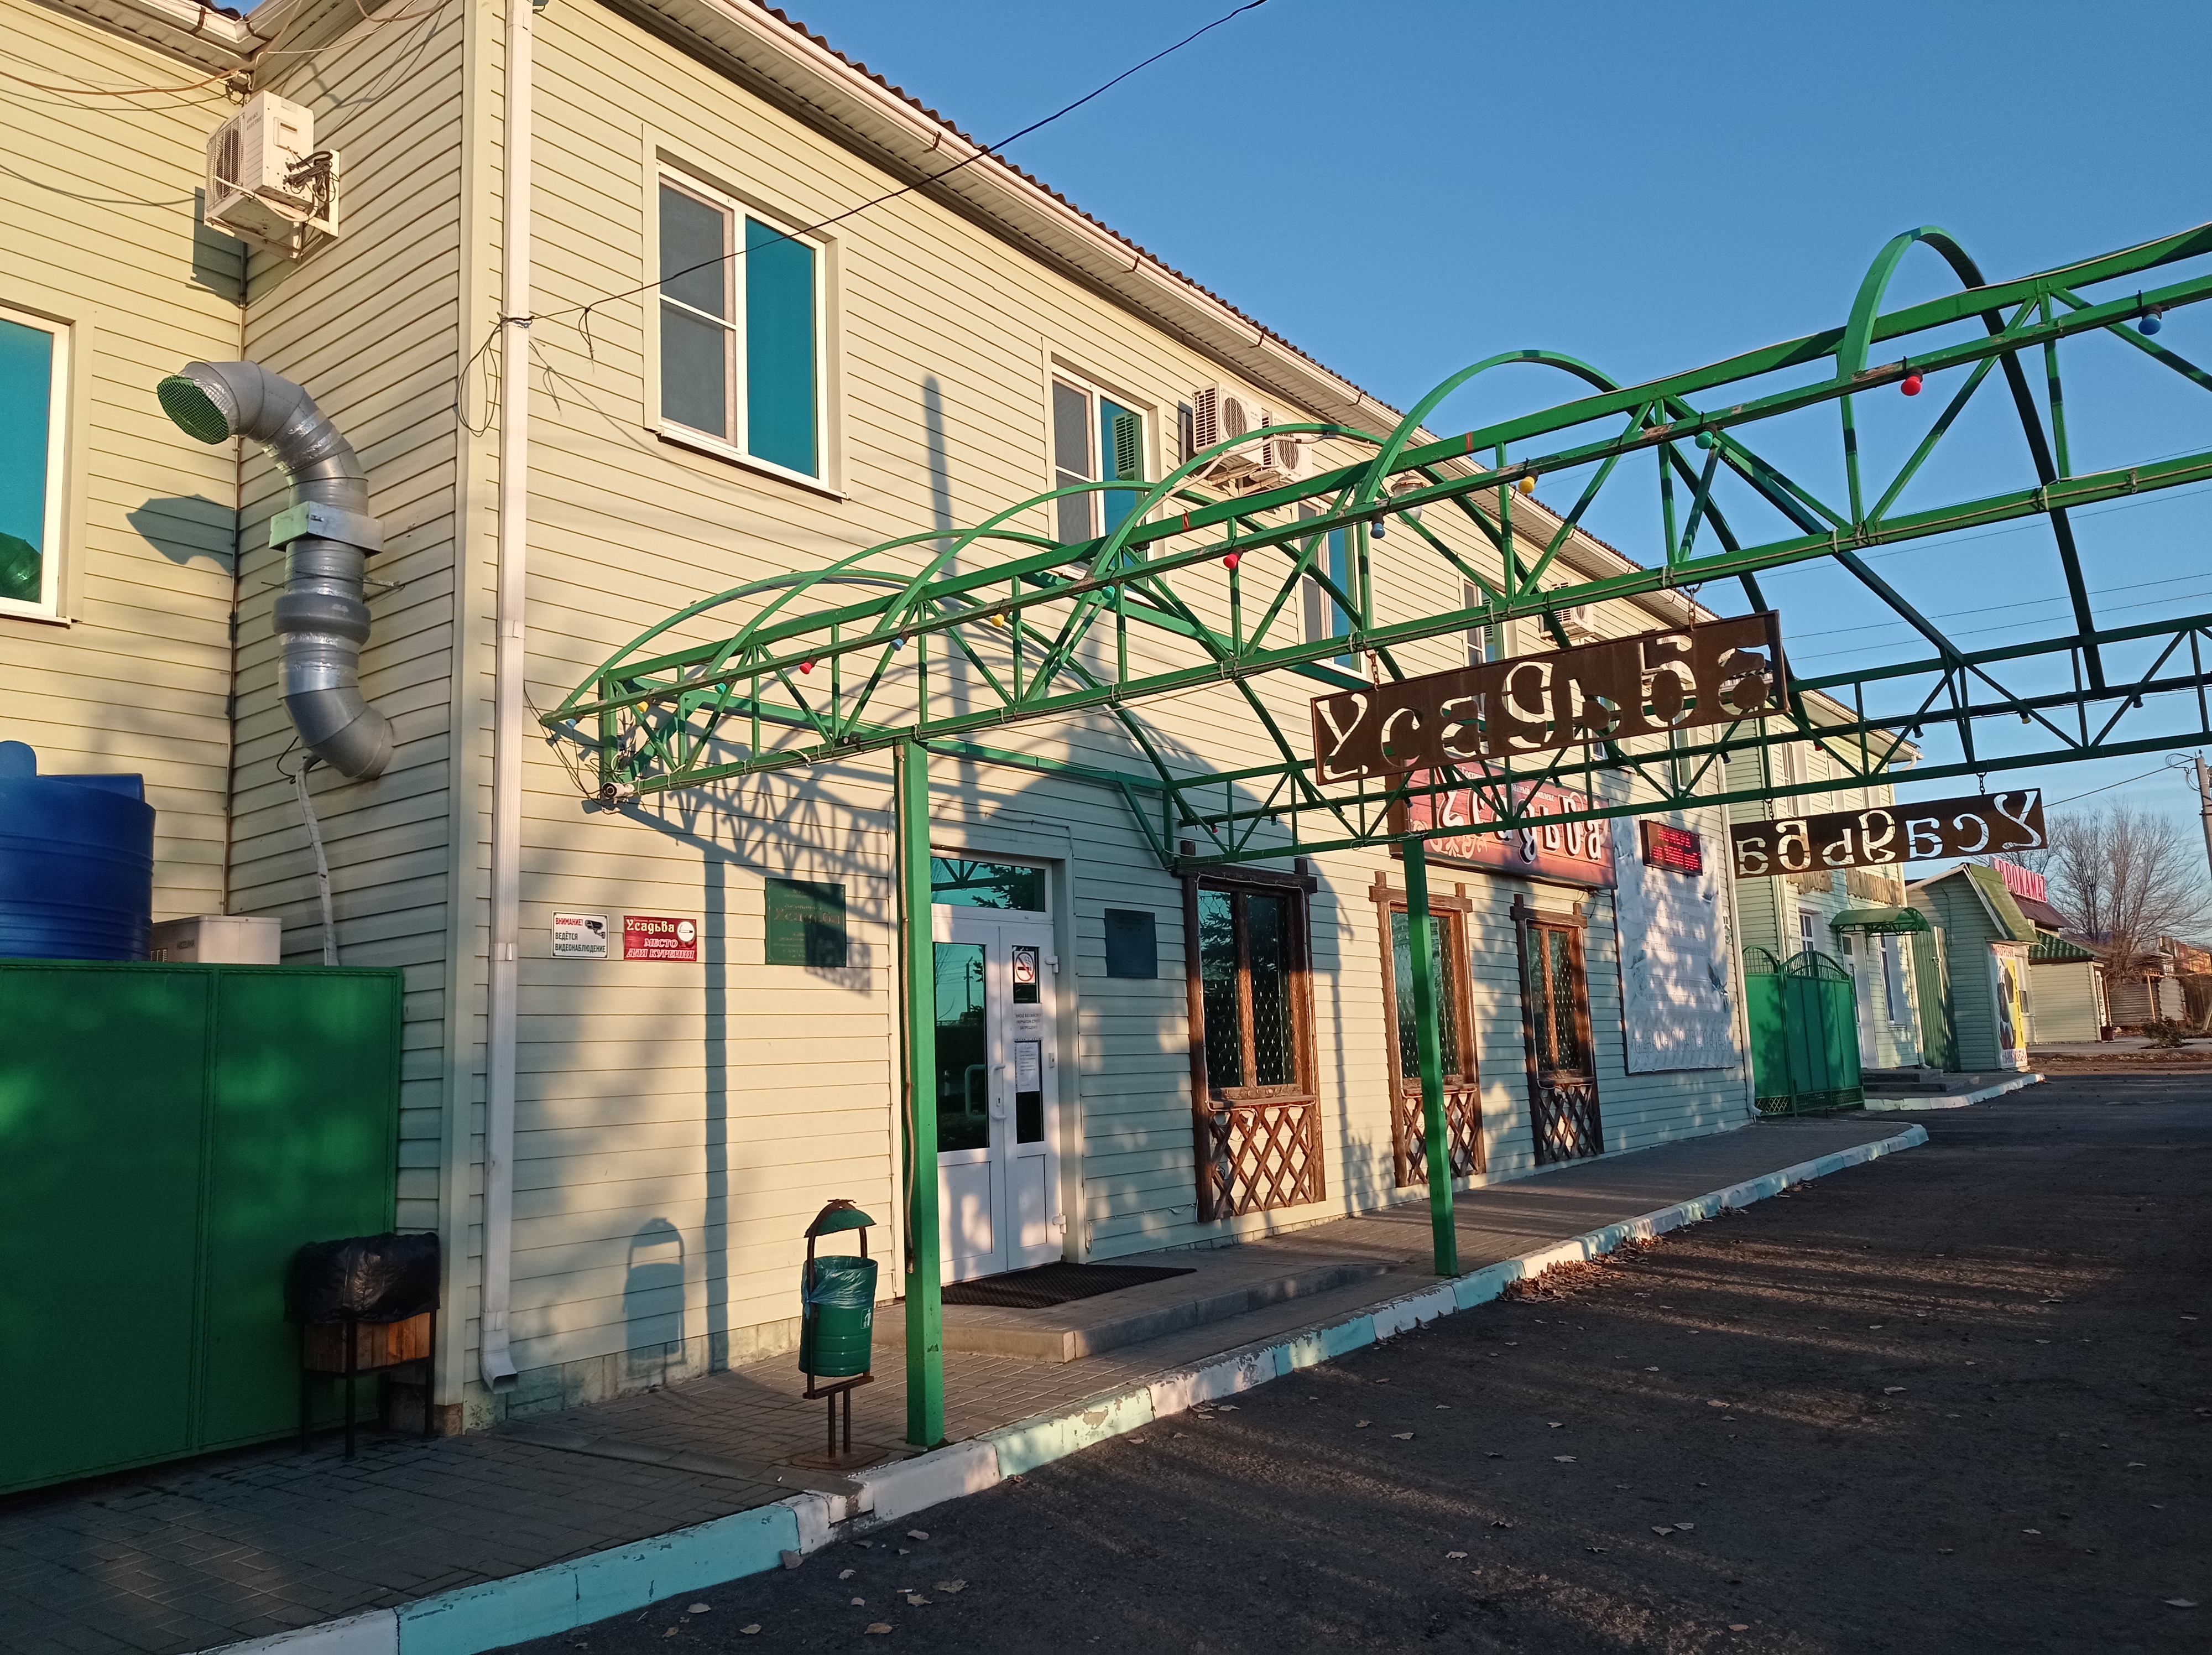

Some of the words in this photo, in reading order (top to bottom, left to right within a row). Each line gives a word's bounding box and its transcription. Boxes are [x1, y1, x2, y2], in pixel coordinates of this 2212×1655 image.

[555, 918, 583, 926] ВНИМАНИЕ!
[626, 919, 675, 934] Усадьба
[555, 931, 578, 940] ВЕДЁТСЯ
[555, 943, 606, 953] ВИДЕОНАБЛЮДЕНИЕ
[644, 938, 679, 948] МЕСТО
[626, 948, 648, 957] ДЛЯ
[649, 949, 695, 959] КУРЕНИЯ
